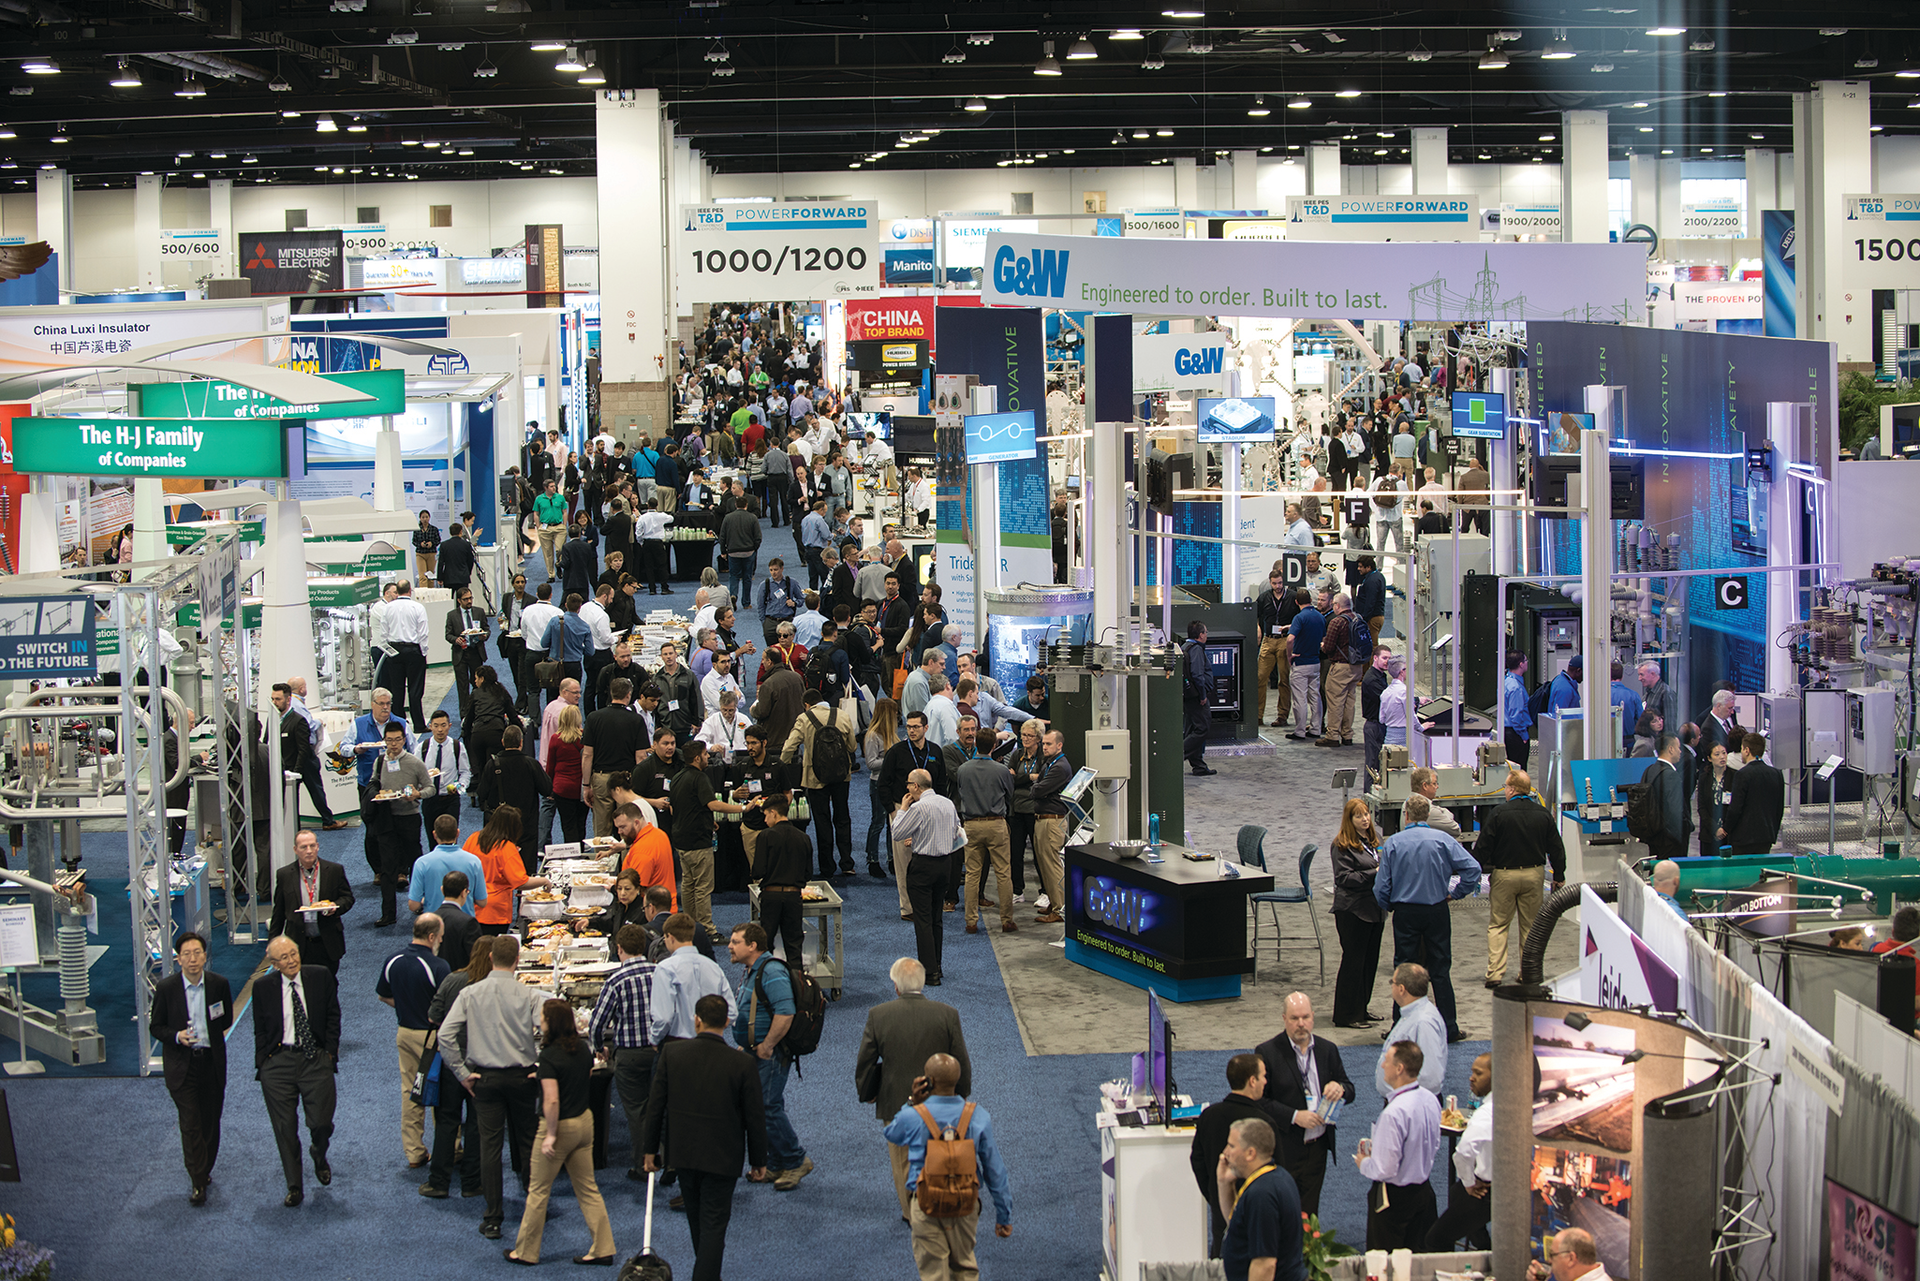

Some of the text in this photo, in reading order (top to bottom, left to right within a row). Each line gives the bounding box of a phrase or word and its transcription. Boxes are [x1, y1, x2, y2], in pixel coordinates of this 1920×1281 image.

[735, 207, 867, 220] POWERFORWARD
[1304, 205, 1330, 215] T&D
[1341, 202, 1469, 212] POWERFORWARD
[1859, 203, 1884, 213] T&D
[697, 214, 724, 224] T&D
[1503, 217, 1561, 226] 1900/2000
[1684, 217, 1739, 226] 2100/2200
[161, 243, 220, 255] 500/600
[278, 247, 338, 259] MITSUBISHI
[278, 257, 331, 269] ELECTRIC
[692, 245, 867, 276] 1000/1200
[993, 245, 1070, 298] G&W
[1081, 282, 1387, 309] Engineered to order. Built to last.
[1685, 295, 1704, 303] THE
[1706, 295, 1745, 303] PROVEN
[863, 310, 924, 326] CHINA
[33, 323, 150, 336] China Luxi Insulator
[864, 327, 924, 337] TOP BRAND
[1174, 347, 1224, 376] G&W
[214, 385, 247, 400] The
[234, 402, 320, 418] of Companies
[79, 425, 204, 452] The H-J Family
[99, 451, 187, 471] of Companies
[1351, 502, 1363, 520] F
[1287, 558, 1302, 582] D
[1720, 580, 1743, 606] C
[16, 640, 88, 655] SWITCH IN
[8, 657, 34, 669] THE
[36, 655, 89, 669] FUTURE
[1083, 875, 1142, 936] G&W
[1749, 895, 1783, 912] BOTTOM
[1077, 929, 1166, 973] Engineered to order. Built to last.
[1599, 953, 1632, 1009] leido
